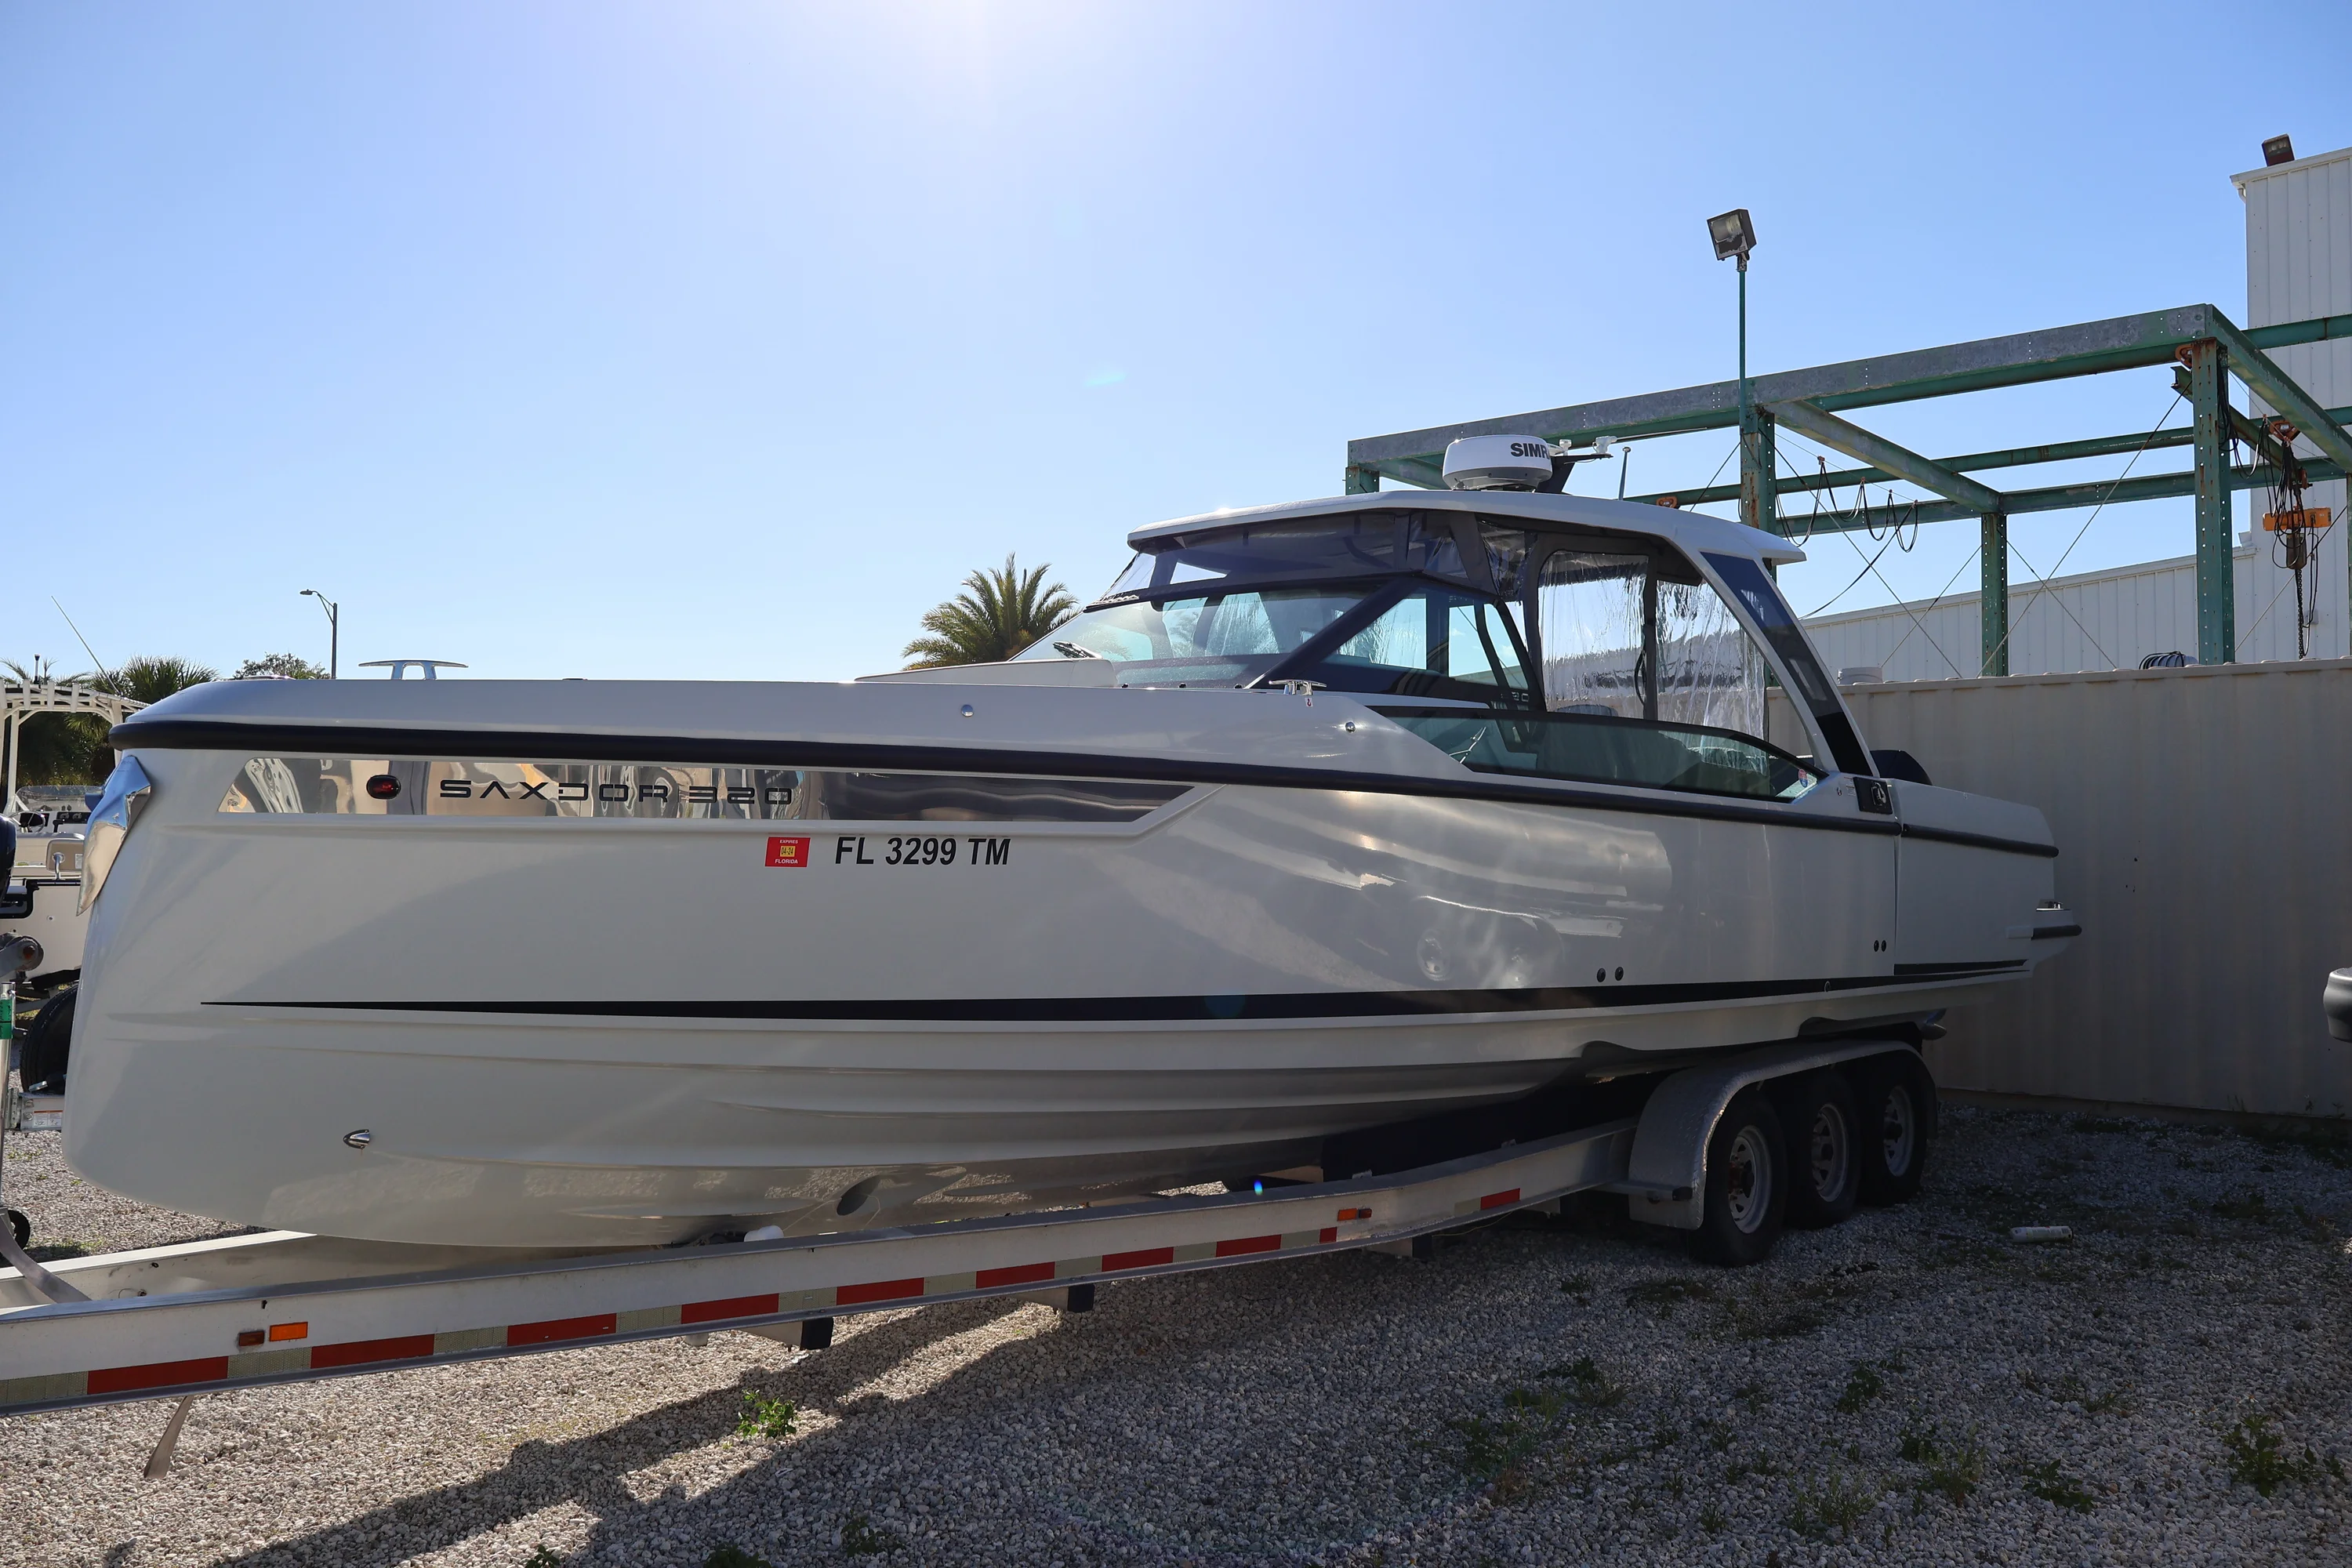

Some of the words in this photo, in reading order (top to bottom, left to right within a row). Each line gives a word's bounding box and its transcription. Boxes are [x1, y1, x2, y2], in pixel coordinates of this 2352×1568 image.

[440, 779, 668, 803] SAXDOR
[688, 786, 792, 804] 320
[835, 837, 874, 865] FL
[885, 837, 956, 866] 3299
[967, 838, 1011, 866] TM
